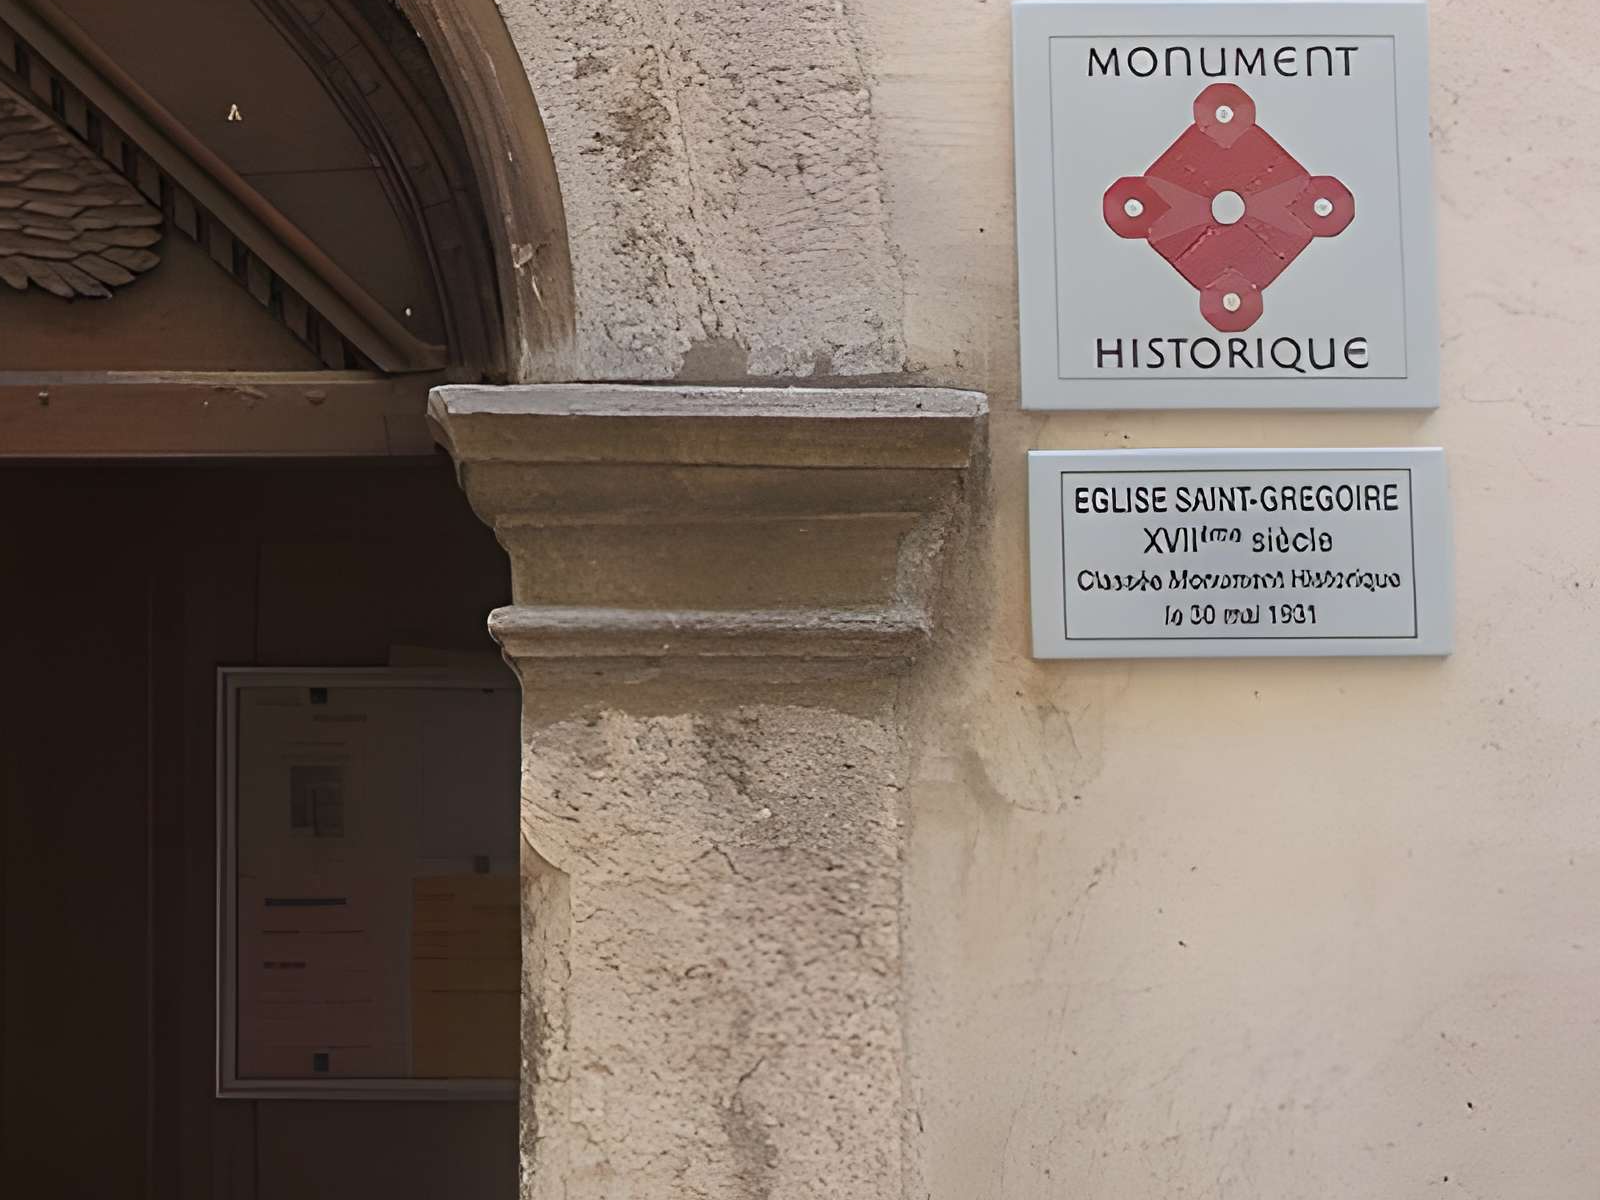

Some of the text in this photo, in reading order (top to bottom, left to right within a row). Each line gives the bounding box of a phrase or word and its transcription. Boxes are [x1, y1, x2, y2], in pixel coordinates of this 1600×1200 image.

[1088, 45, 1359, 78] MONUMENT
[1096, 336, 1369, 374] HISTORIQUE
[1075, 483, 1399, 514] EGLISE SAINT-GREGOIRE
[1252, 526, 1333, 554] siècle
